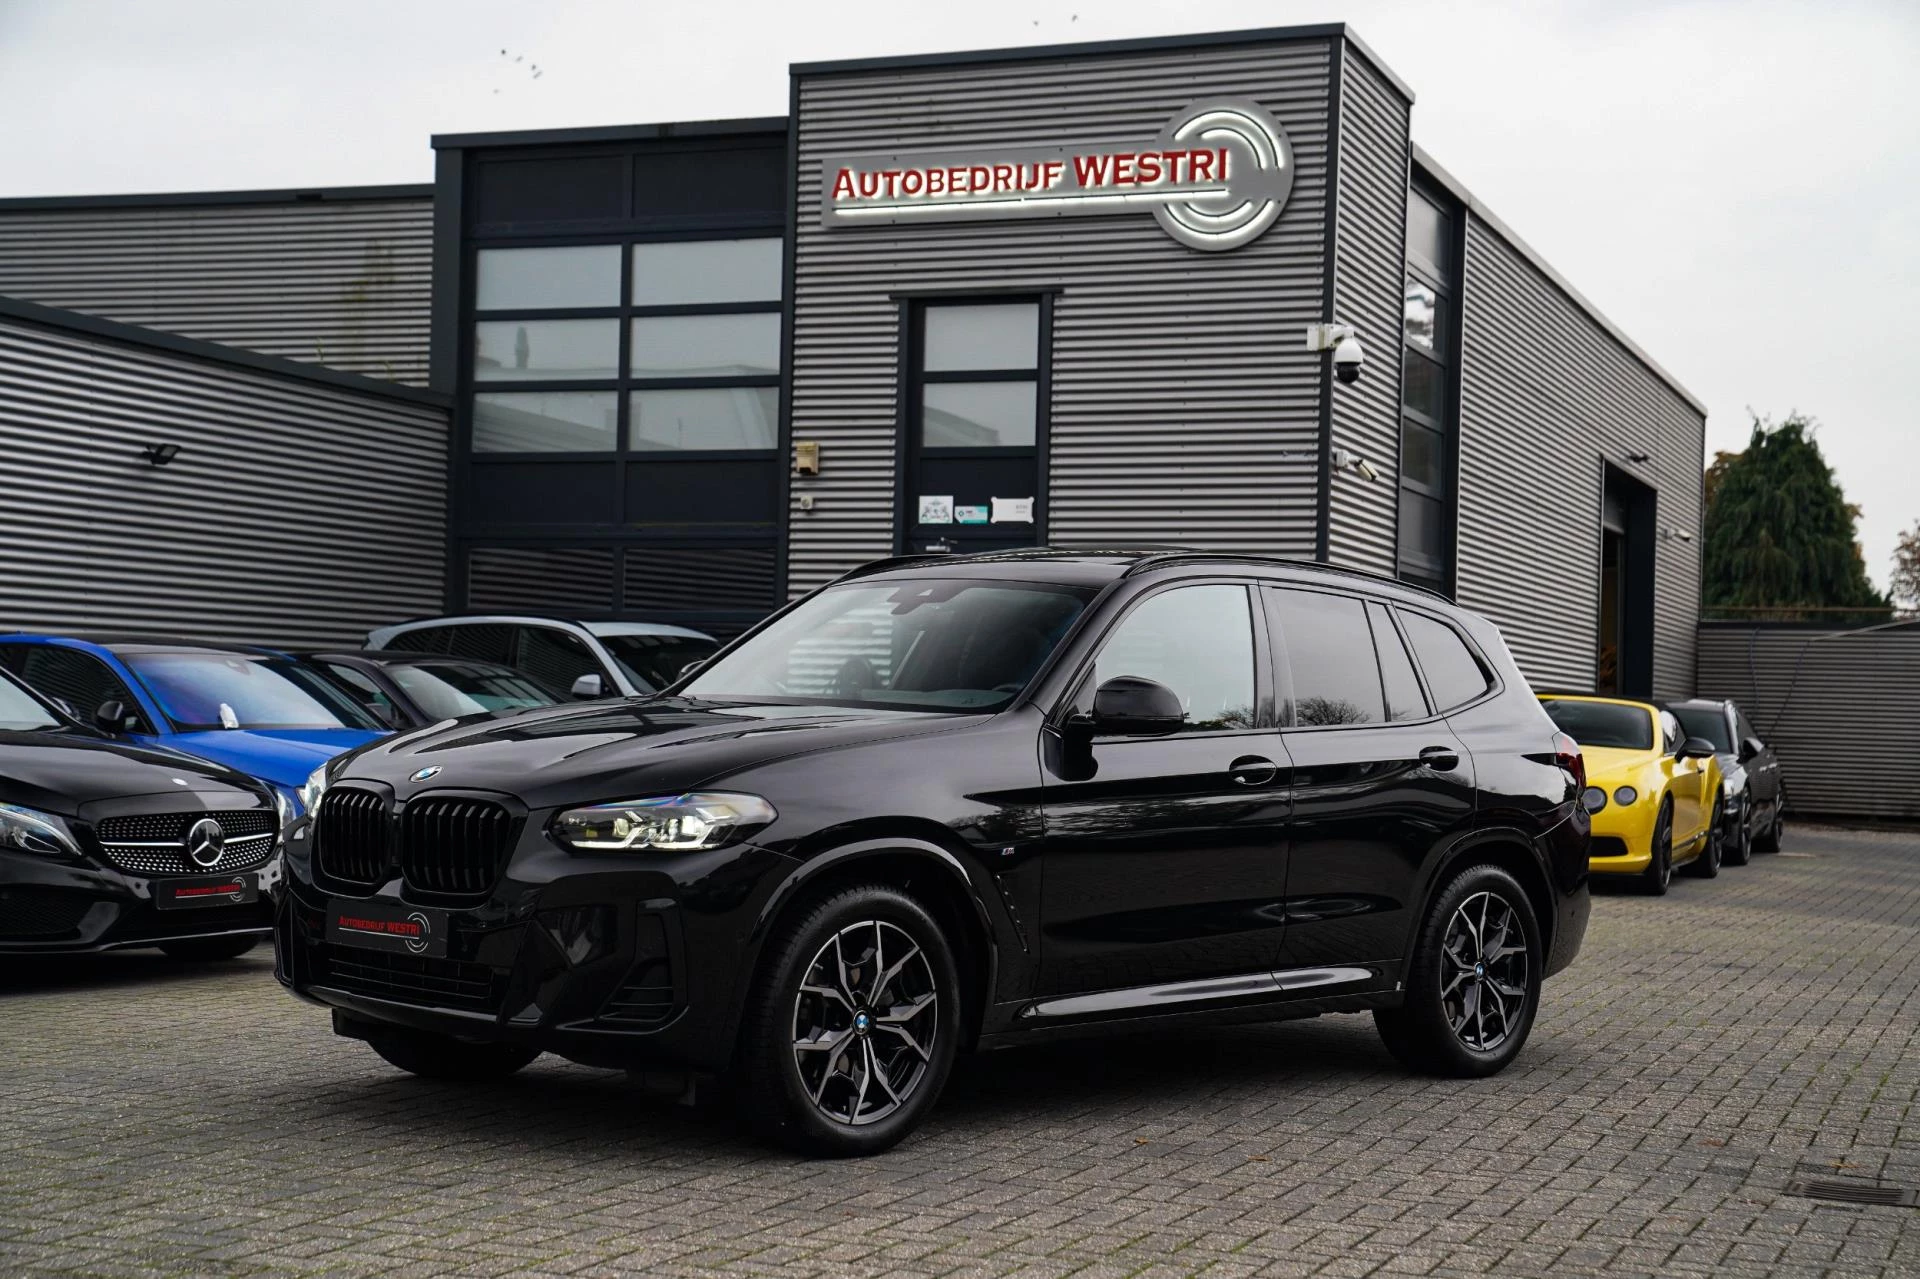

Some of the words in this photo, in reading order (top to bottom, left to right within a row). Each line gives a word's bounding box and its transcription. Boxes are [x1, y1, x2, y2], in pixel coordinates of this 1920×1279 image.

[831, 162, 1062, 198] AUTOBEDRIJF
[1073, 148, 1228, 187] WESTRI
[386, 921, 420, 935] WESTRI
